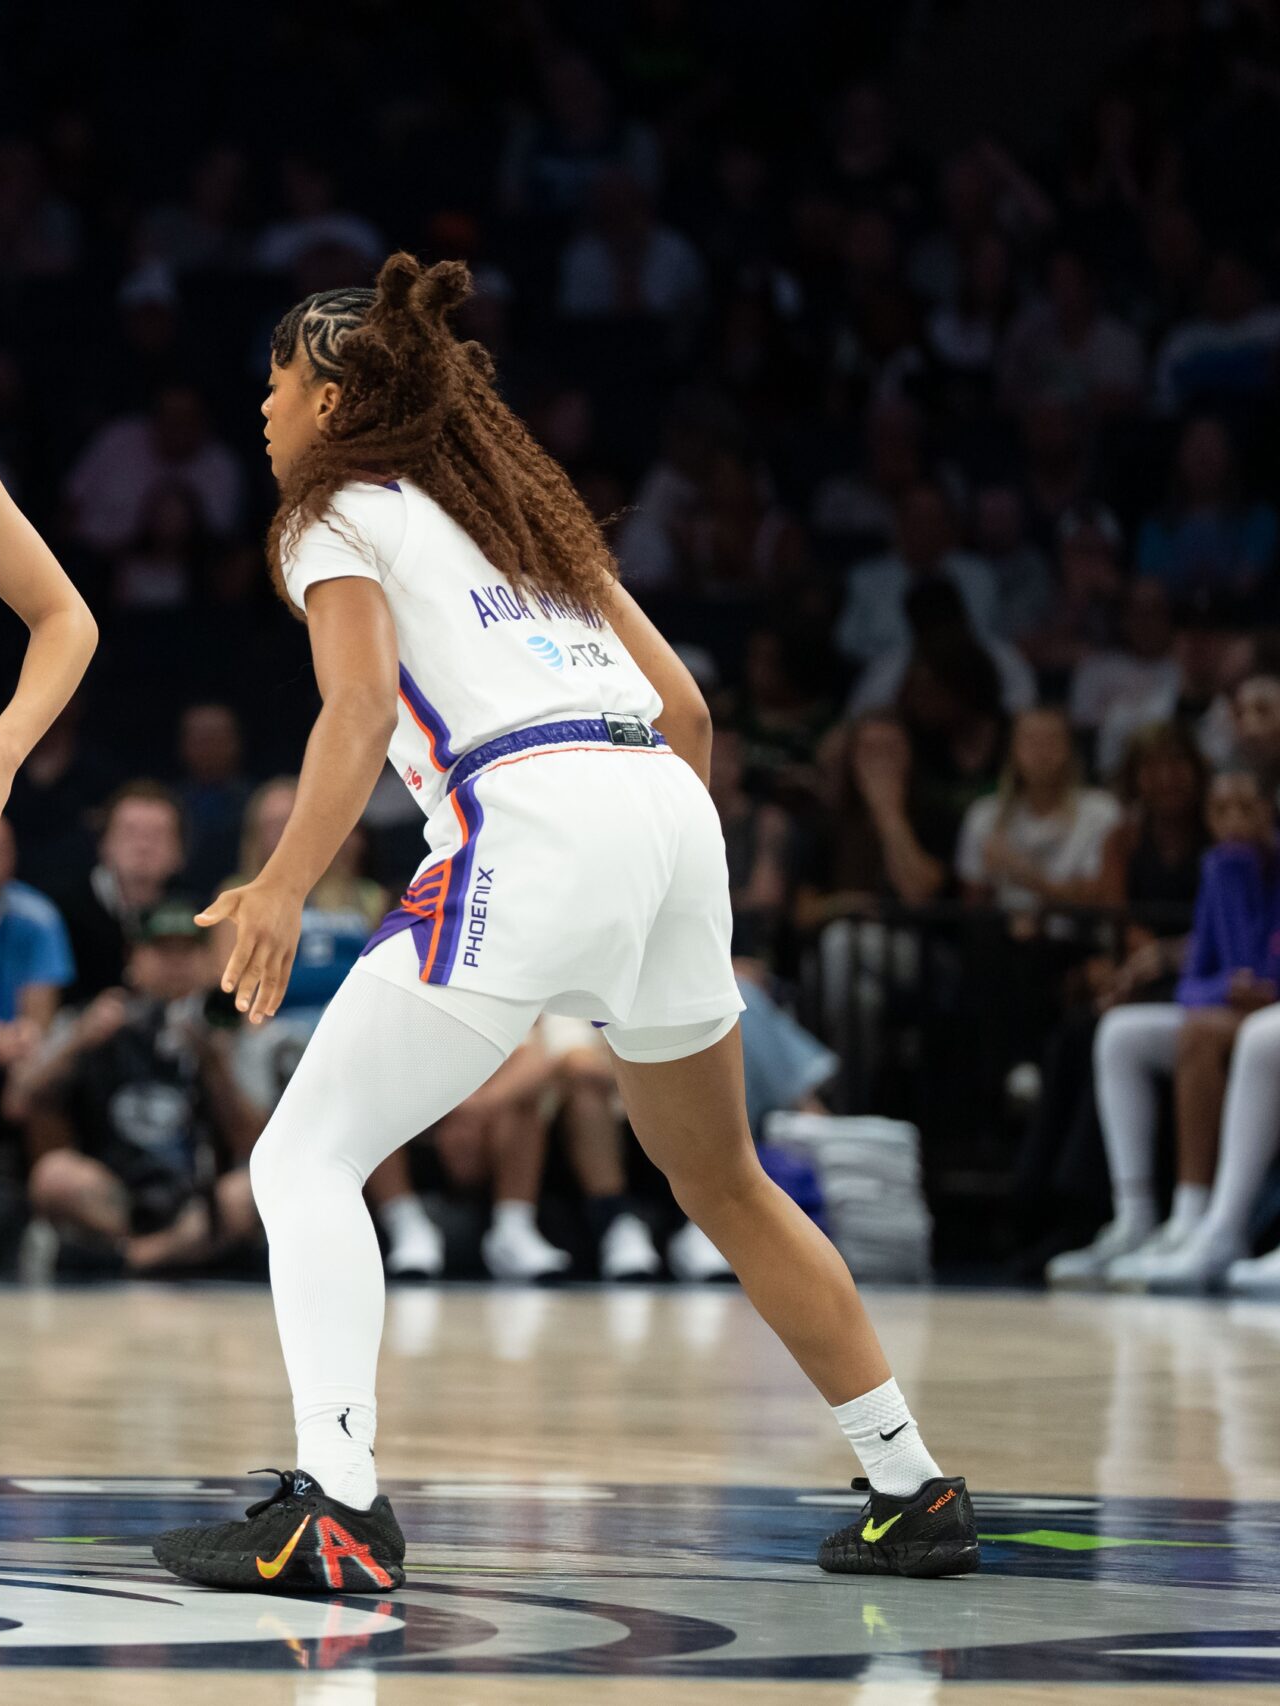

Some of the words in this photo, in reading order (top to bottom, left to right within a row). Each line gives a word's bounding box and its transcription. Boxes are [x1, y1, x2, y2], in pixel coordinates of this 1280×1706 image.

[470, 585, 536, 629] AKOA
[565, 642, 618, 668] AT&
[463, 866, 495, 968] PHOENIX
[927, 1488, 957, 1514] TWELVE
